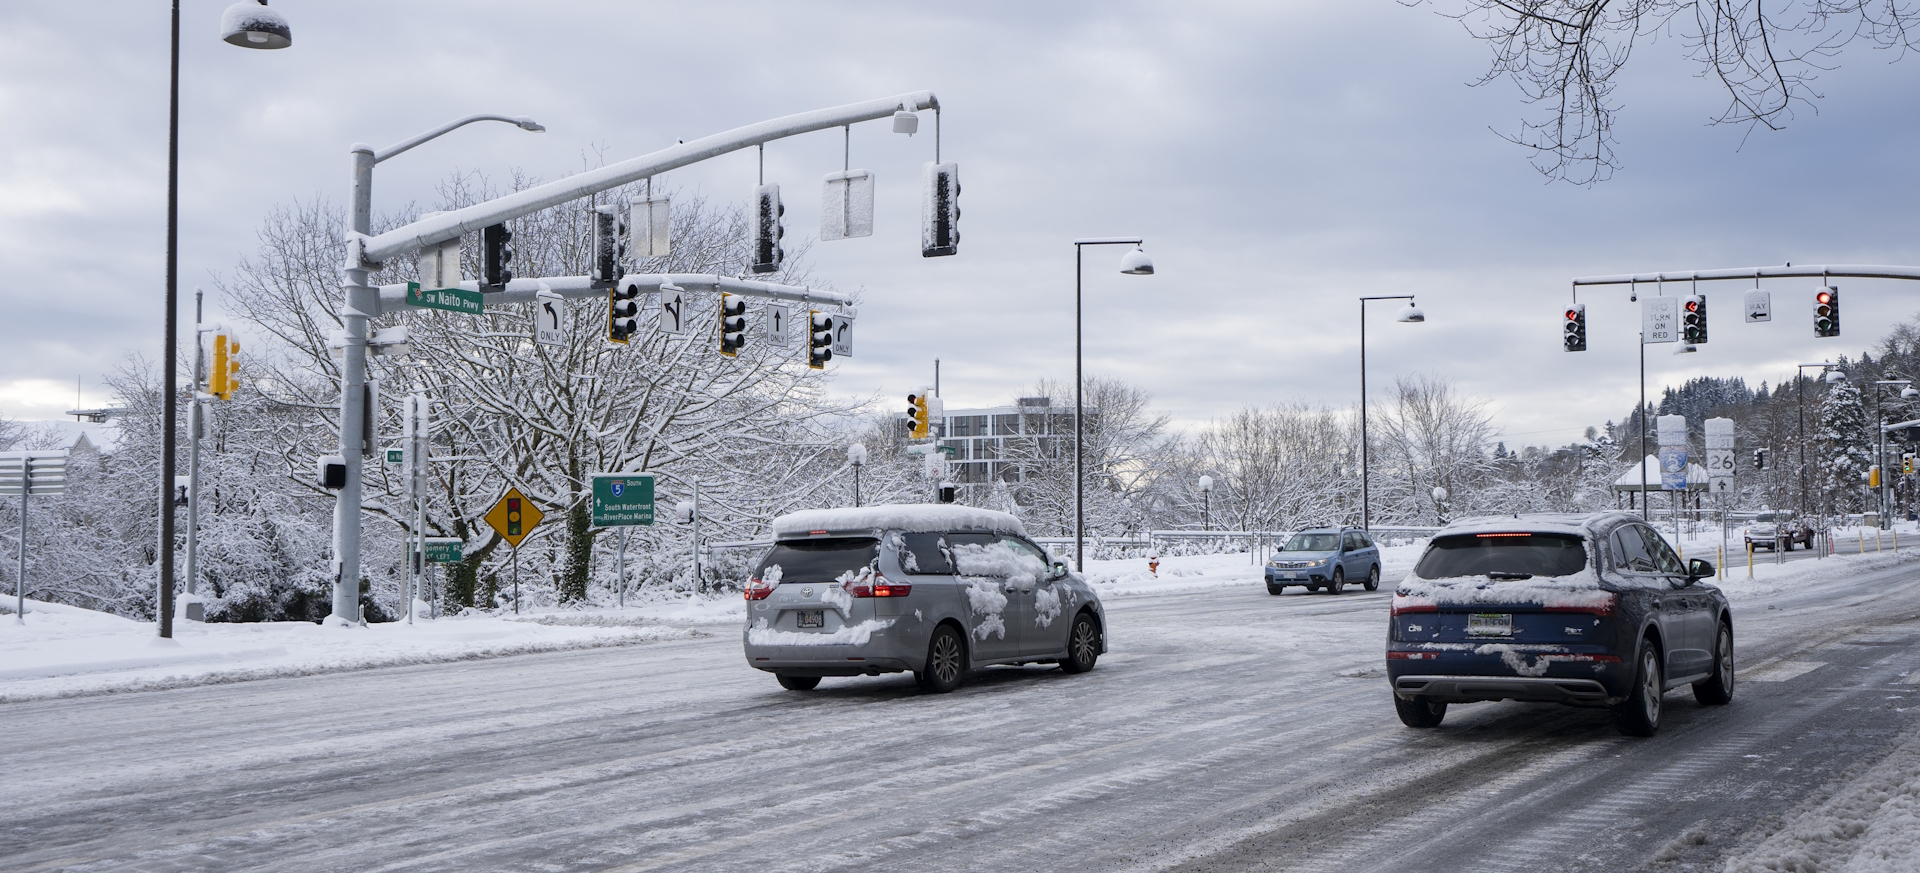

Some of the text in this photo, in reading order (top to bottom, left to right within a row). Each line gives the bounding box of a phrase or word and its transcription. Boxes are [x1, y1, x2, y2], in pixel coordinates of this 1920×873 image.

[426, 291, 479, 312] SW Naito Pkwy
[1748, 302, 1767, 311] WAY
[1650, 313, 1671, 322] TURN
[540, 330, 560, 342] ONLY
[770, 334, 785, 343] ONLY
[1652, 331, 1668, 339] RED
[1668, 453, 1679, 470] 5
[1710, 454, 1733, 470] 26
[615, 484, 621, 495] 5
